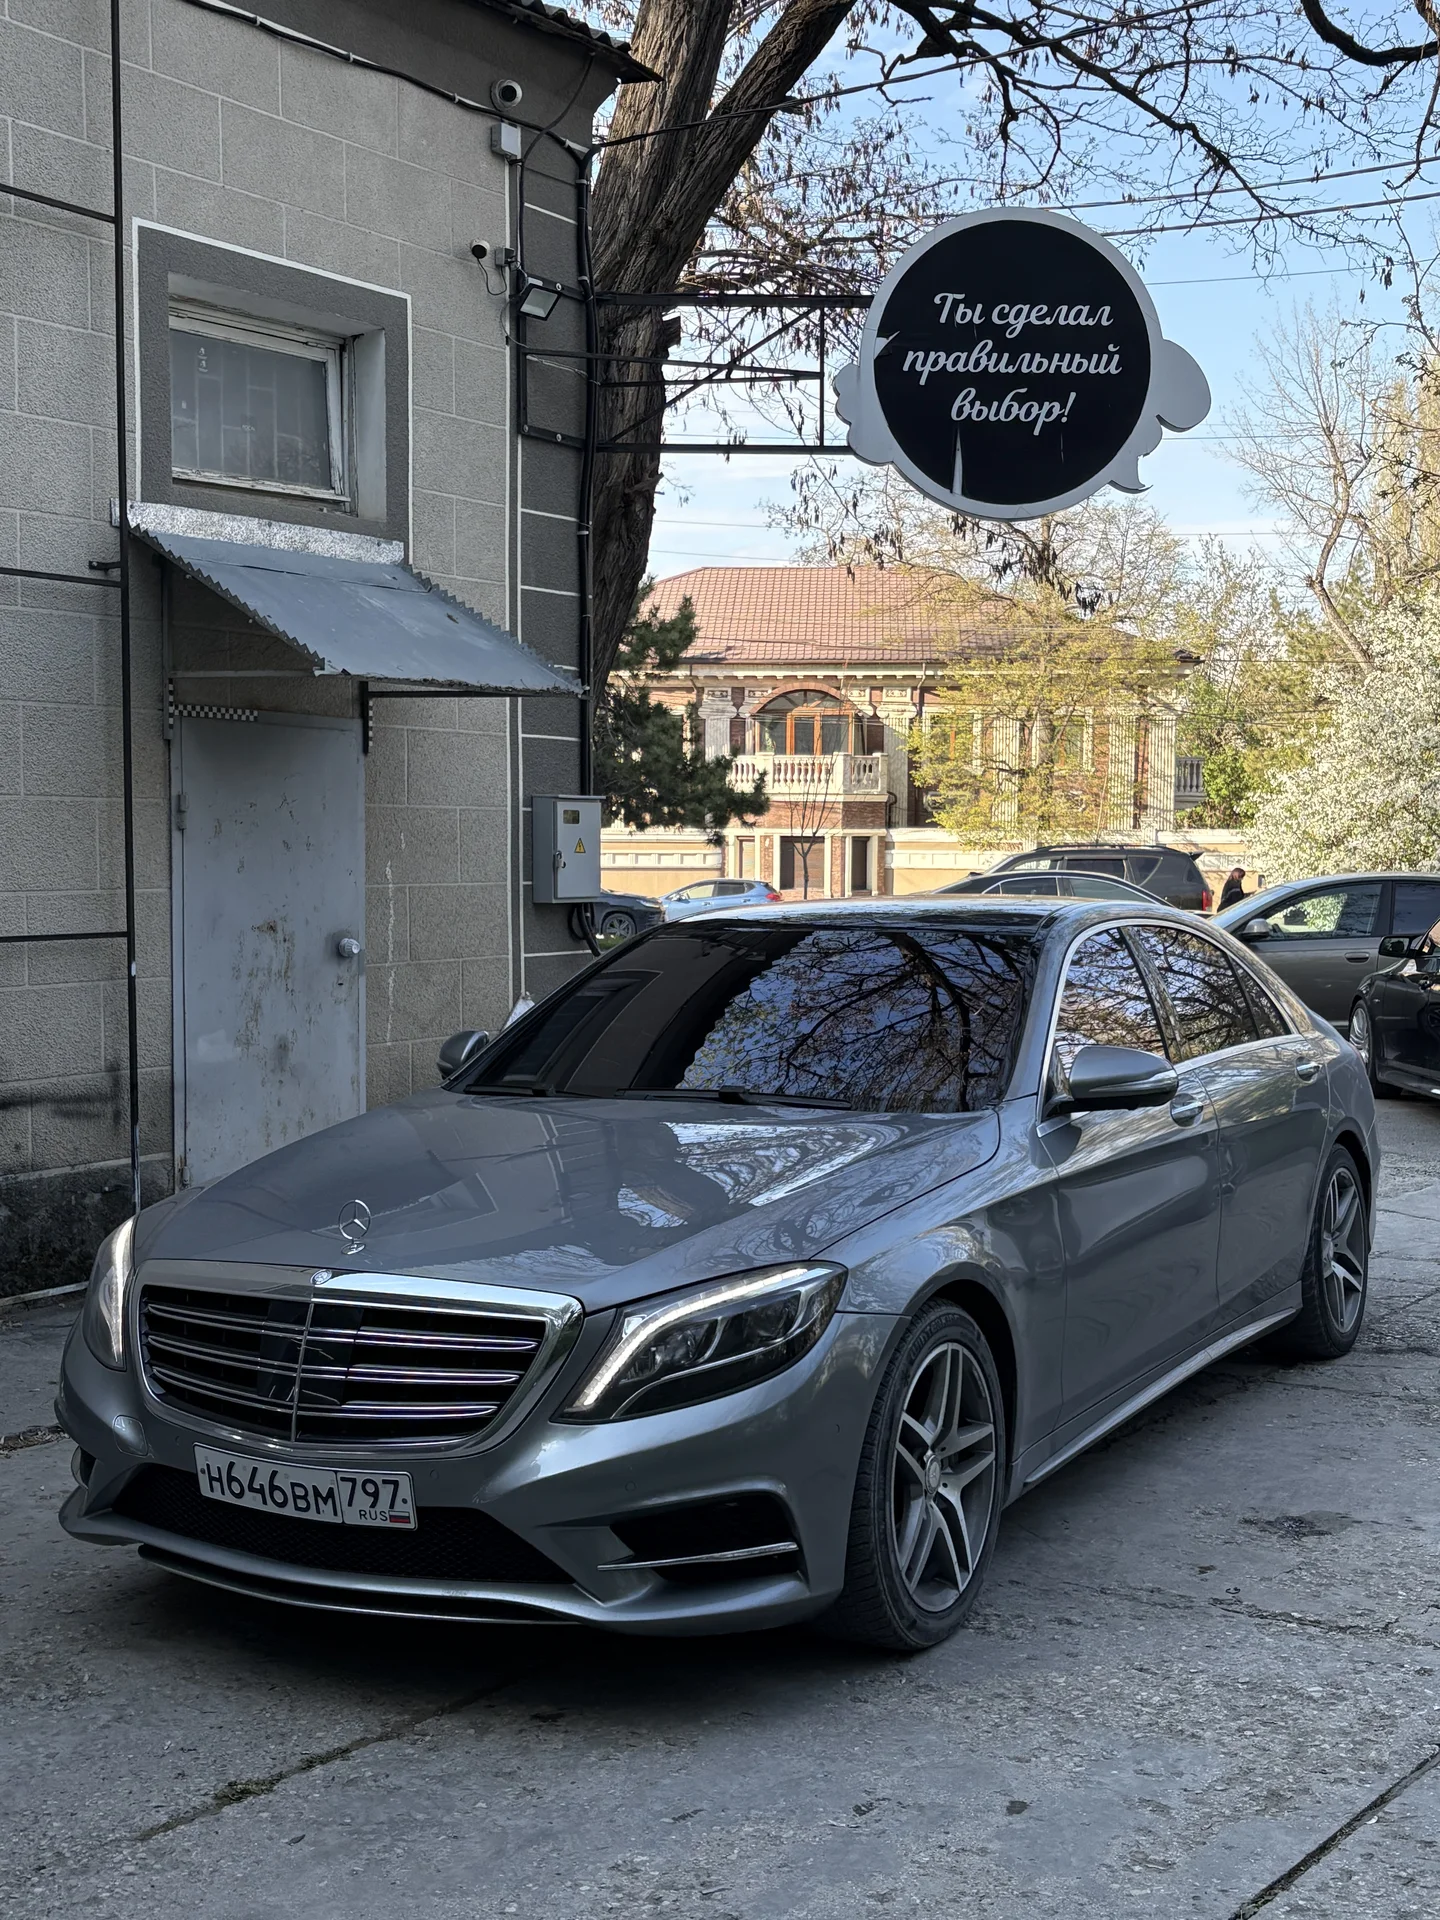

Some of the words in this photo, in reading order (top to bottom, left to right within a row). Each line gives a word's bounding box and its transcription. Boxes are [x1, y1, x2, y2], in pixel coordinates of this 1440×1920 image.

[933, 292, 985, 324] Ты
[991, 301, 1113, 338] сделал
[902, 339, 1122, 386] правильный
[950, 386, 1077, 436] выбор!
[340, 1476, 400, 1509] 797
[358, 1509, 388, 1522] RUS
